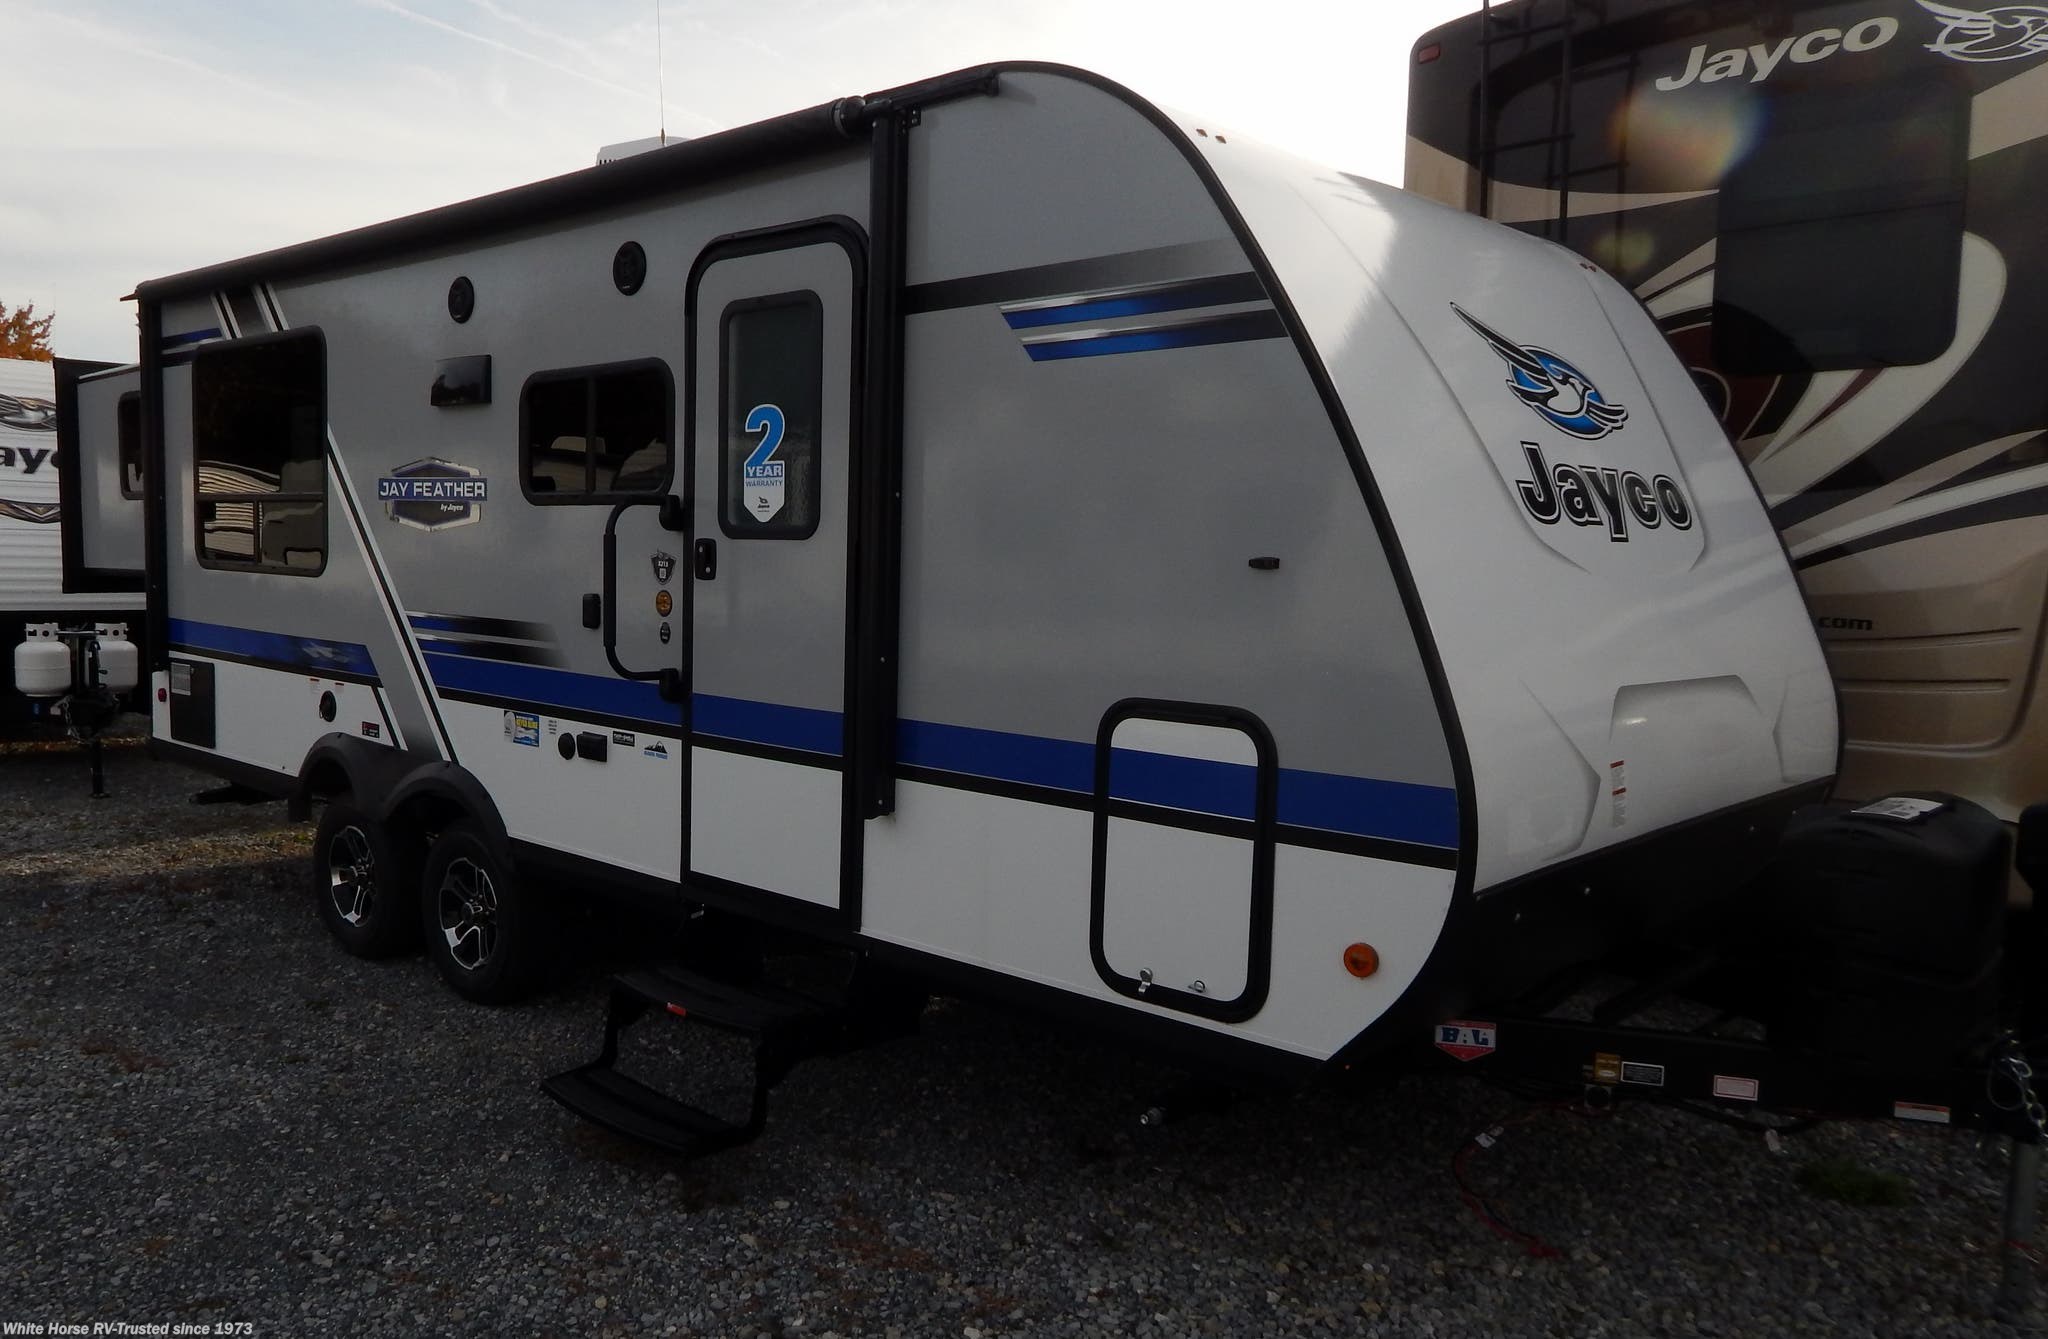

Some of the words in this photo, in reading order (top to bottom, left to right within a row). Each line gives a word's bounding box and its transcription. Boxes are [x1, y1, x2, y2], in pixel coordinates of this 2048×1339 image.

[1655, 17, 1899, 91] Jayco
[745, 404, 785, 464] 2
[747, 466, 783, 478] YEAR
[380, 482, 408, 497] JAY
[414, 482, 485, 497] FEATHER
[1515, 441, 1692, 542] Jayco
[440, 503, 447, 512] by
[448, 503, 463, 512] Jayco
[1441, 1027, 1489, 1046] BAL
